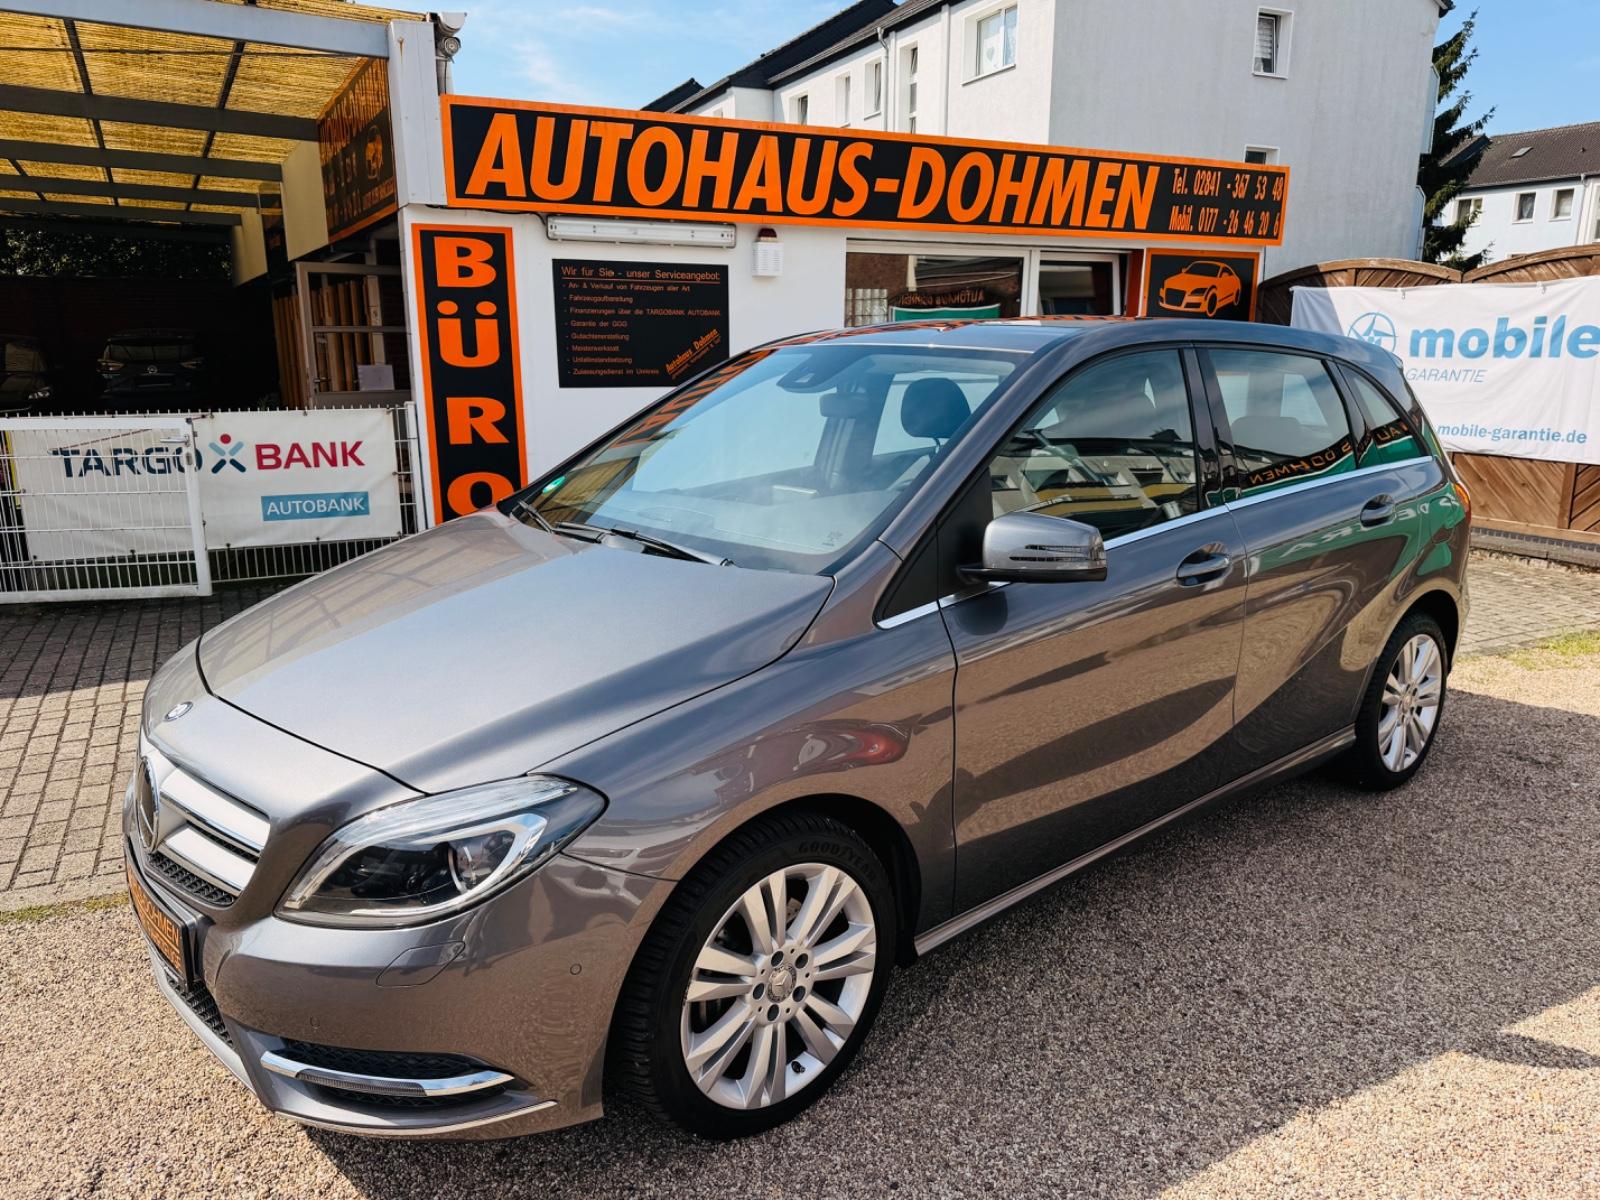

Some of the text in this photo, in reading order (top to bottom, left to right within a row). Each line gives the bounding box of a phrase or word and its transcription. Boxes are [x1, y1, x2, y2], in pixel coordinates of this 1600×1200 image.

[465, 112, 1160, 230] AUTOHAUS-DOHMEN
[1172, 168, 1188, 194] Tel.
[1193, 169, 1222, 196] 02841
[1254, 175, 1267, 200] 53
[1168, 204, 1193, 232] Mobil.
[1198, 206, 1219, 232] 0177
[1243, 210, 1255, 235] 46
[1258, 211, 1270, 236] 20
[561, 266, 577, 276] Wir
[581, 266, 594, 277] für
[599, 267, 613, 277] Sie
[626, 270, 650, 278] unser
[687, 309, 720, 317] AUTOBANK
[1409, 314, 1600, 359] mobile
[434, 236, 515, 516] BÜRO
[1407, 367, 1487, 383] GARANTIE
[255, 440, 365, 471] BANK
[266, 497, 365, 516] AUTOBANK
